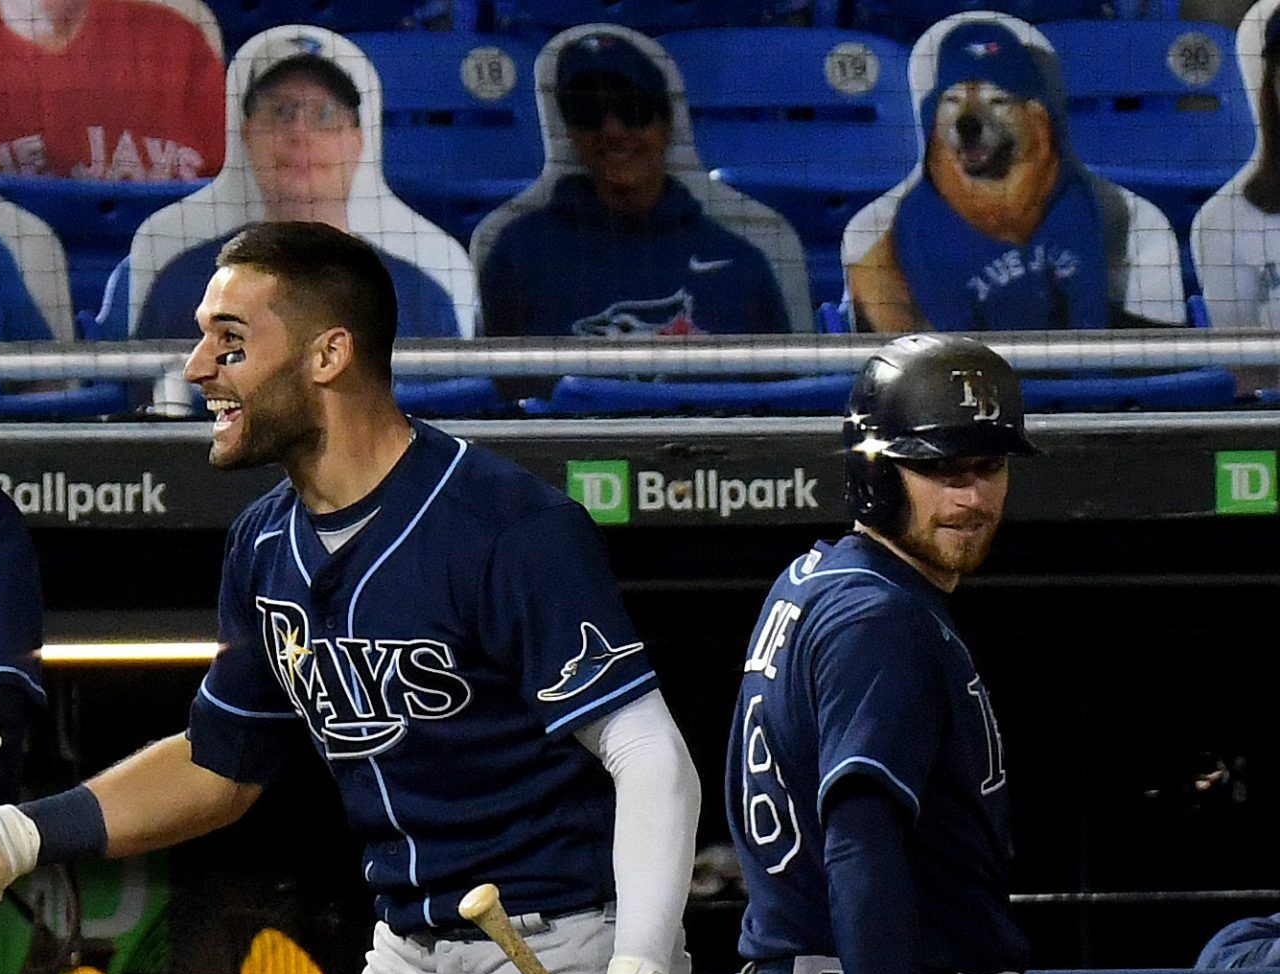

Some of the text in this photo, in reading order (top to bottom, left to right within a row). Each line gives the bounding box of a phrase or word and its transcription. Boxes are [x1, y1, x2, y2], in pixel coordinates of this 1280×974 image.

[572, 467, 820, 518] TD Ballpark
[1221, 462, 1271, 501] TD
[255, 595, 471, 761] RAYS
